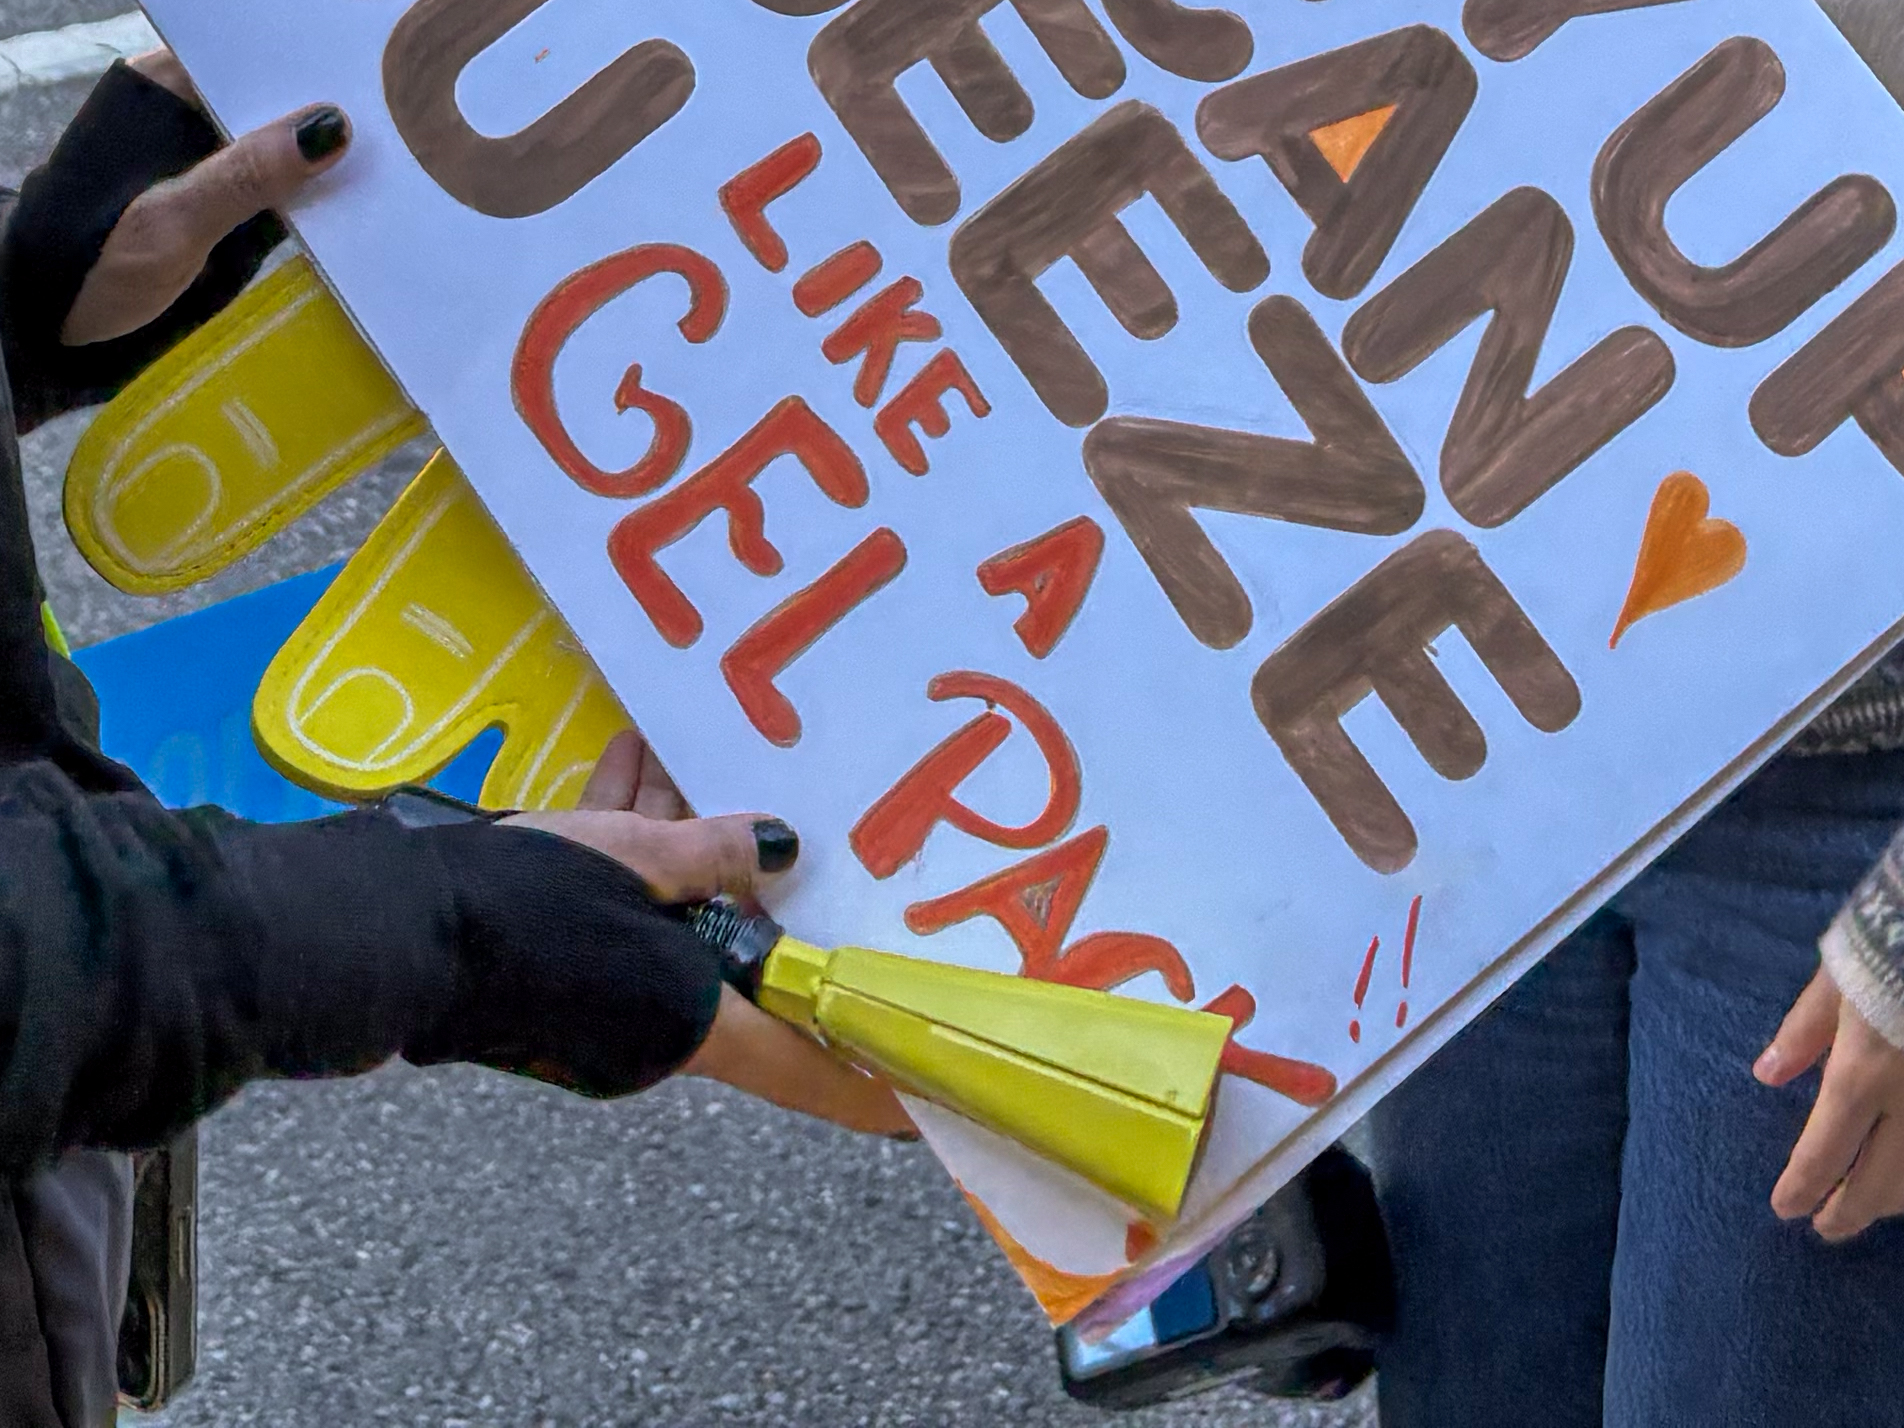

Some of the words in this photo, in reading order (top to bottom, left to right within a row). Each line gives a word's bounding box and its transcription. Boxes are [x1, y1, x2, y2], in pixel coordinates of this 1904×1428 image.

[511, 244, 906, 747] GEL
[718, 132, 990, 475] LIKE
[976, 516, 1104, 658] A
